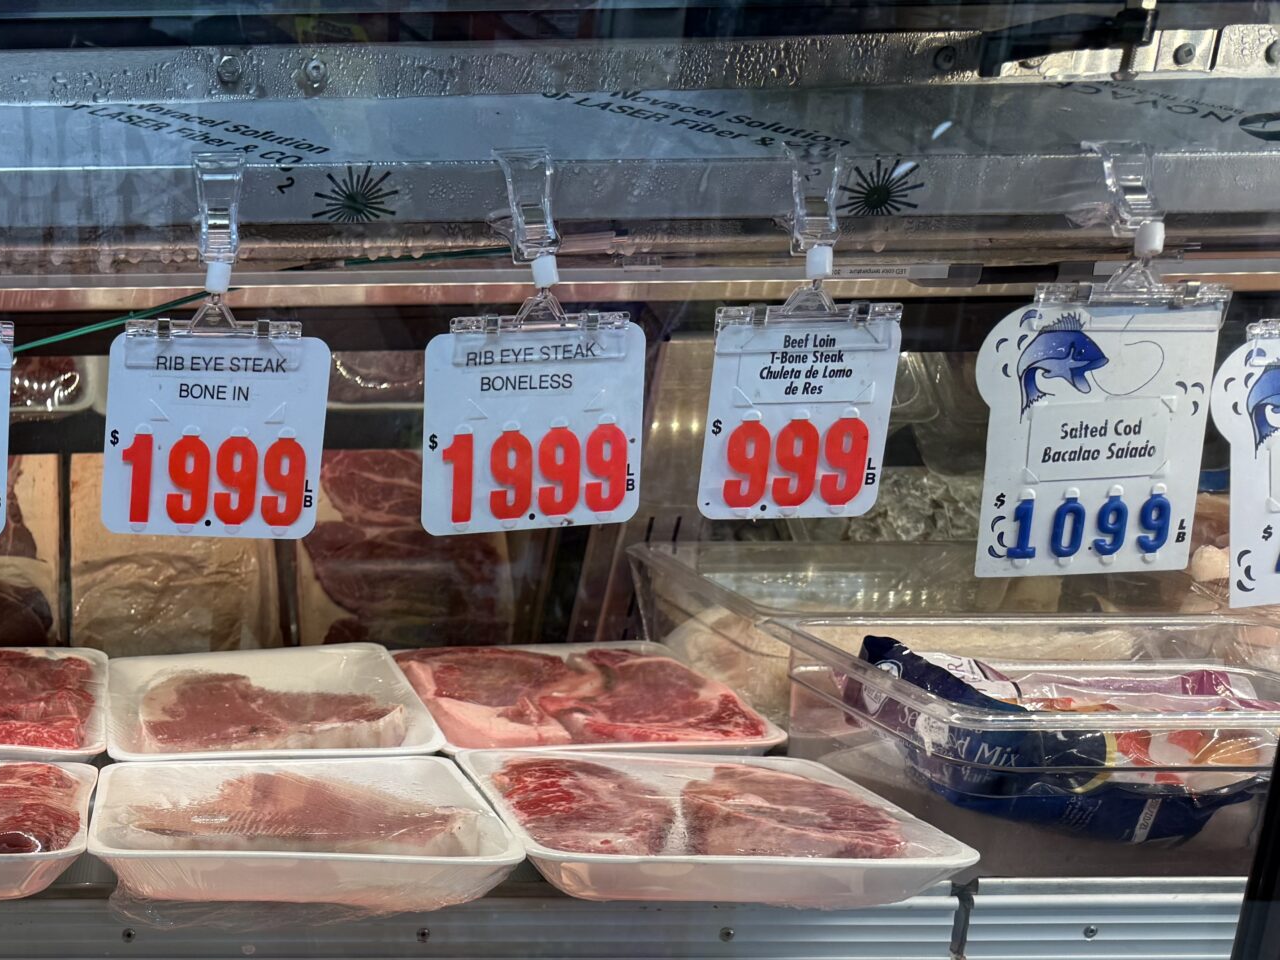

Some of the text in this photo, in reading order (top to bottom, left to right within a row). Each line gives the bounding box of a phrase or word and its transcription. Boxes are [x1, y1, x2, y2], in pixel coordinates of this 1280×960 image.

[574, 97, 670, 122] LASER
[671, 119, 749, 139] Fiber
[89, 107, 170, 131] LASER
[169, 128, 236, 148] Fiber
[224, 124, 330, 154] Solution
[783, 334, 836, 348] Beef Loin
[466, 343, 596, 366] RIB EYE STEAK
[770, 350, 843, 364] T-Bone Steak
[156, 356, 287, 372] RIB EYE STEAK
[760, 366, 852, 380] Chuleta de Lomo
[481, 374, 572, 391] BONELESS
[785, 382, 823, 395] de Res
[179, 383, 249, 401] BONE IN
[712, 419, 722, 435] $
[1061, 418, 1141, 439] Salted Cod
[110, 429, 119, 446] $
[429, 434, 438, 451] $
[1042, 446, 1100, 463] Bacalao
[994, 493, 1006, 508] $
[975, 743, 1019, 766] Mix
